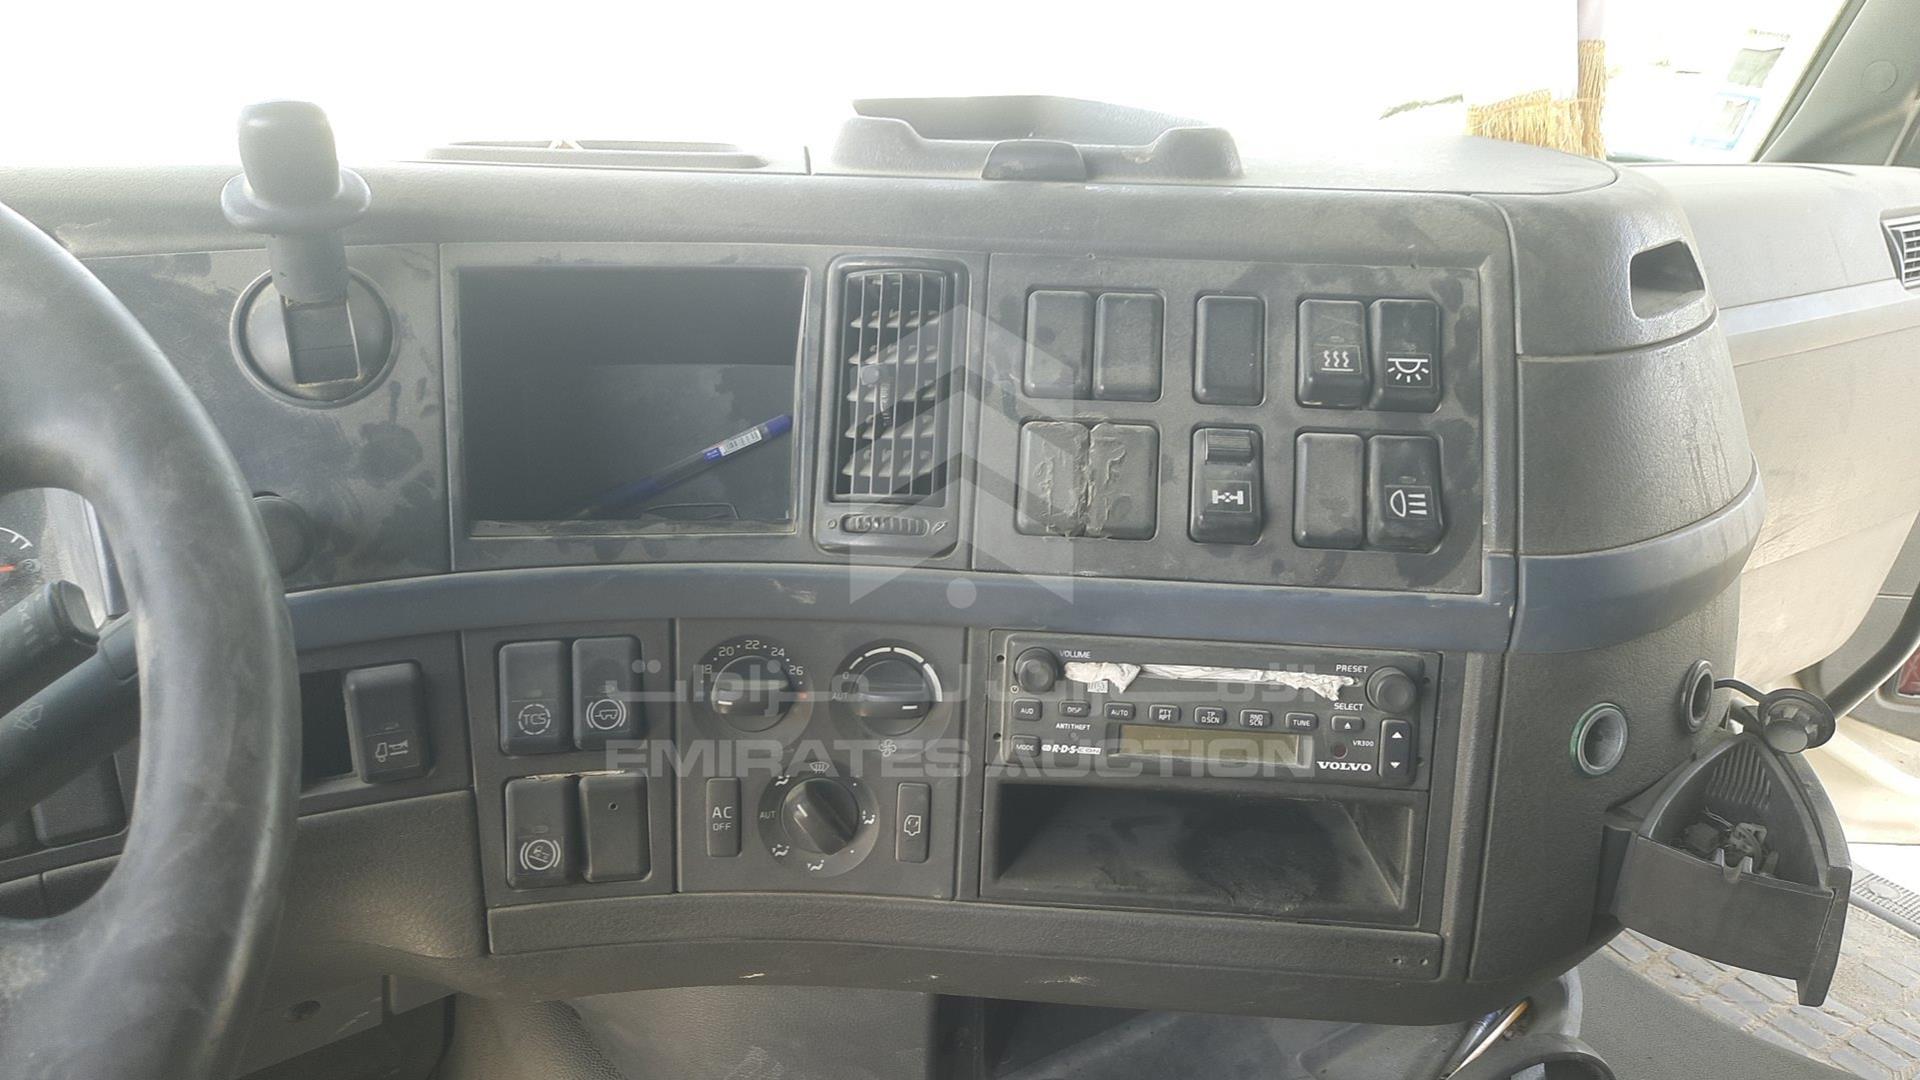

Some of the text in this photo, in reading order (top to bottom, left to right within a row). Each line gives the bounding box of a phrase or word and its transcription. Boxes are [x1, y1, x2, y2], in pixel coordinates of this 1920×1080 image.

[745, 640, 760, 650] 22
[718, 646, 735, 657] 20
[771, 647, 785, 657] 24
[1060, 649, 1091, 659] VOLUME
[789, 665, 804, 676] 26
[1335, 664, 1369, 673] PRESET
[1334, 702, 1364, 711] SELECT
[522, 712, 547, 725] TCS
[1293, 719, 1311, 727] TUNE
[1016, 744, 1034, 752] MODE
[1316, 761, 1373, 773] VOLVO
[712, 806, 733, 819] AC
[712, 822, 732, 832] OFF
